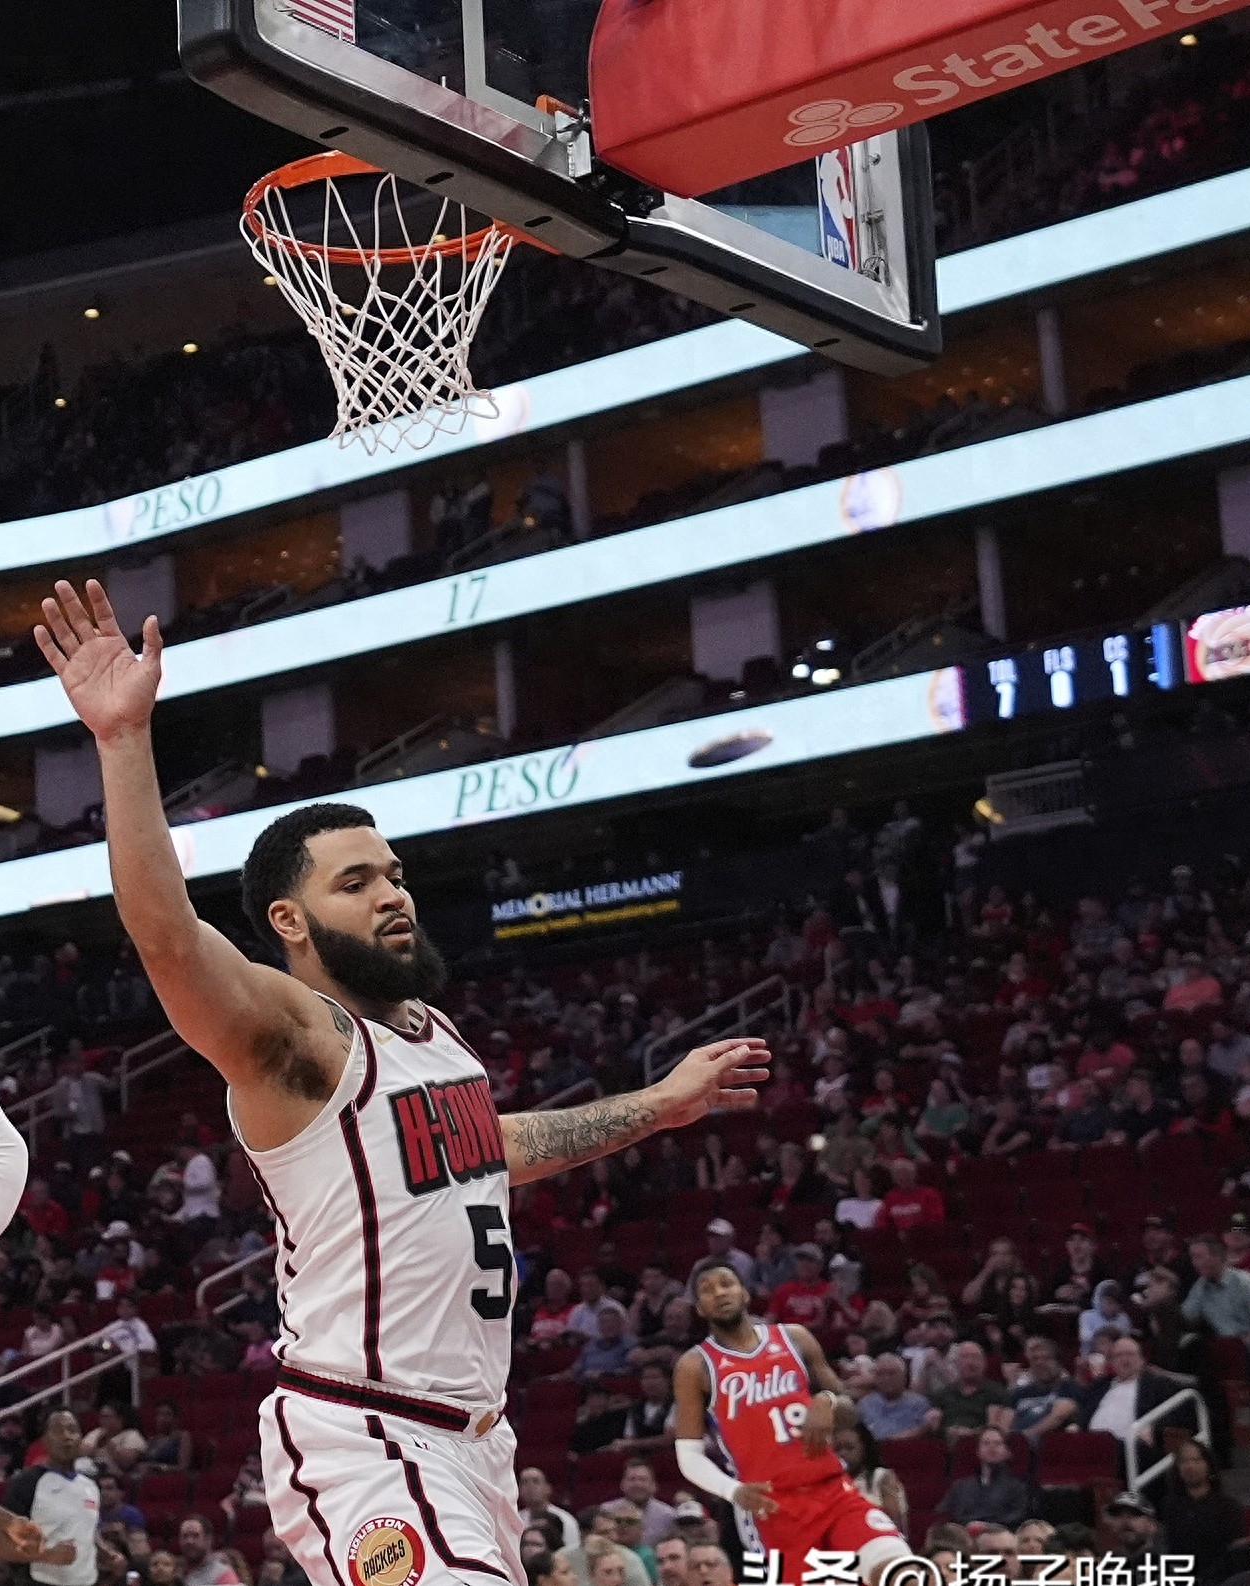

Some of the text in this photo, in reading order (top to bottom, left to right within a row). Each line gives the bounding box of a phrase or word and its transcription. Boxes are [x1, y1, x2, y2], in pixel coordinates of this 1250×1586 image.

[128, 475, 223, 536] PESO
[447, 576, 487, 622] 17
[996, 681, 1015, 719] 7
[1110, 659, 1129, 696] 1
[454, 750, 579, 818] PESO
[492, 887, 582, 921] MEMORIAL
[585, 871, 684, 906] HERMANN
[466, 1204, 513, 1322] 5
[720, 1365, 798, 1420] Phila
[768, 1402, 809, 1442] 19
[348, 1519, 406, 1561] HOUSTON
